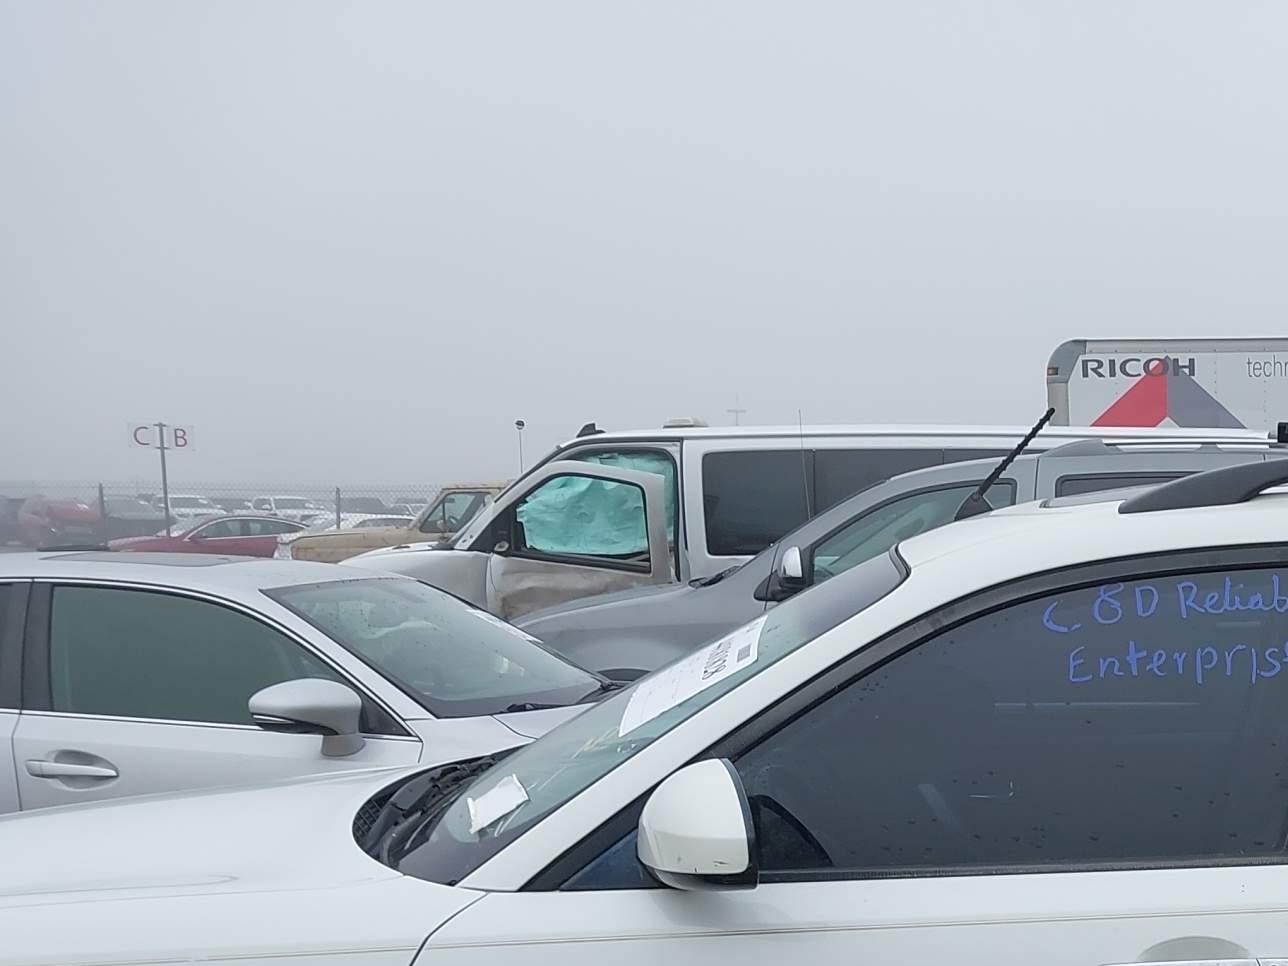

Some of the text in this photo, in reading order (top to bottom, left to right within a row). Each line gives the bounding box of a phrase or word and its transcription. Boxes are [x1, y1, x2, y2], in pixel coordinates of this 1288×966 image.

[1081, 357, 1196, 379] RICOH
[133, 426, 151, 446] C
[174, 428, 188, 448] B
